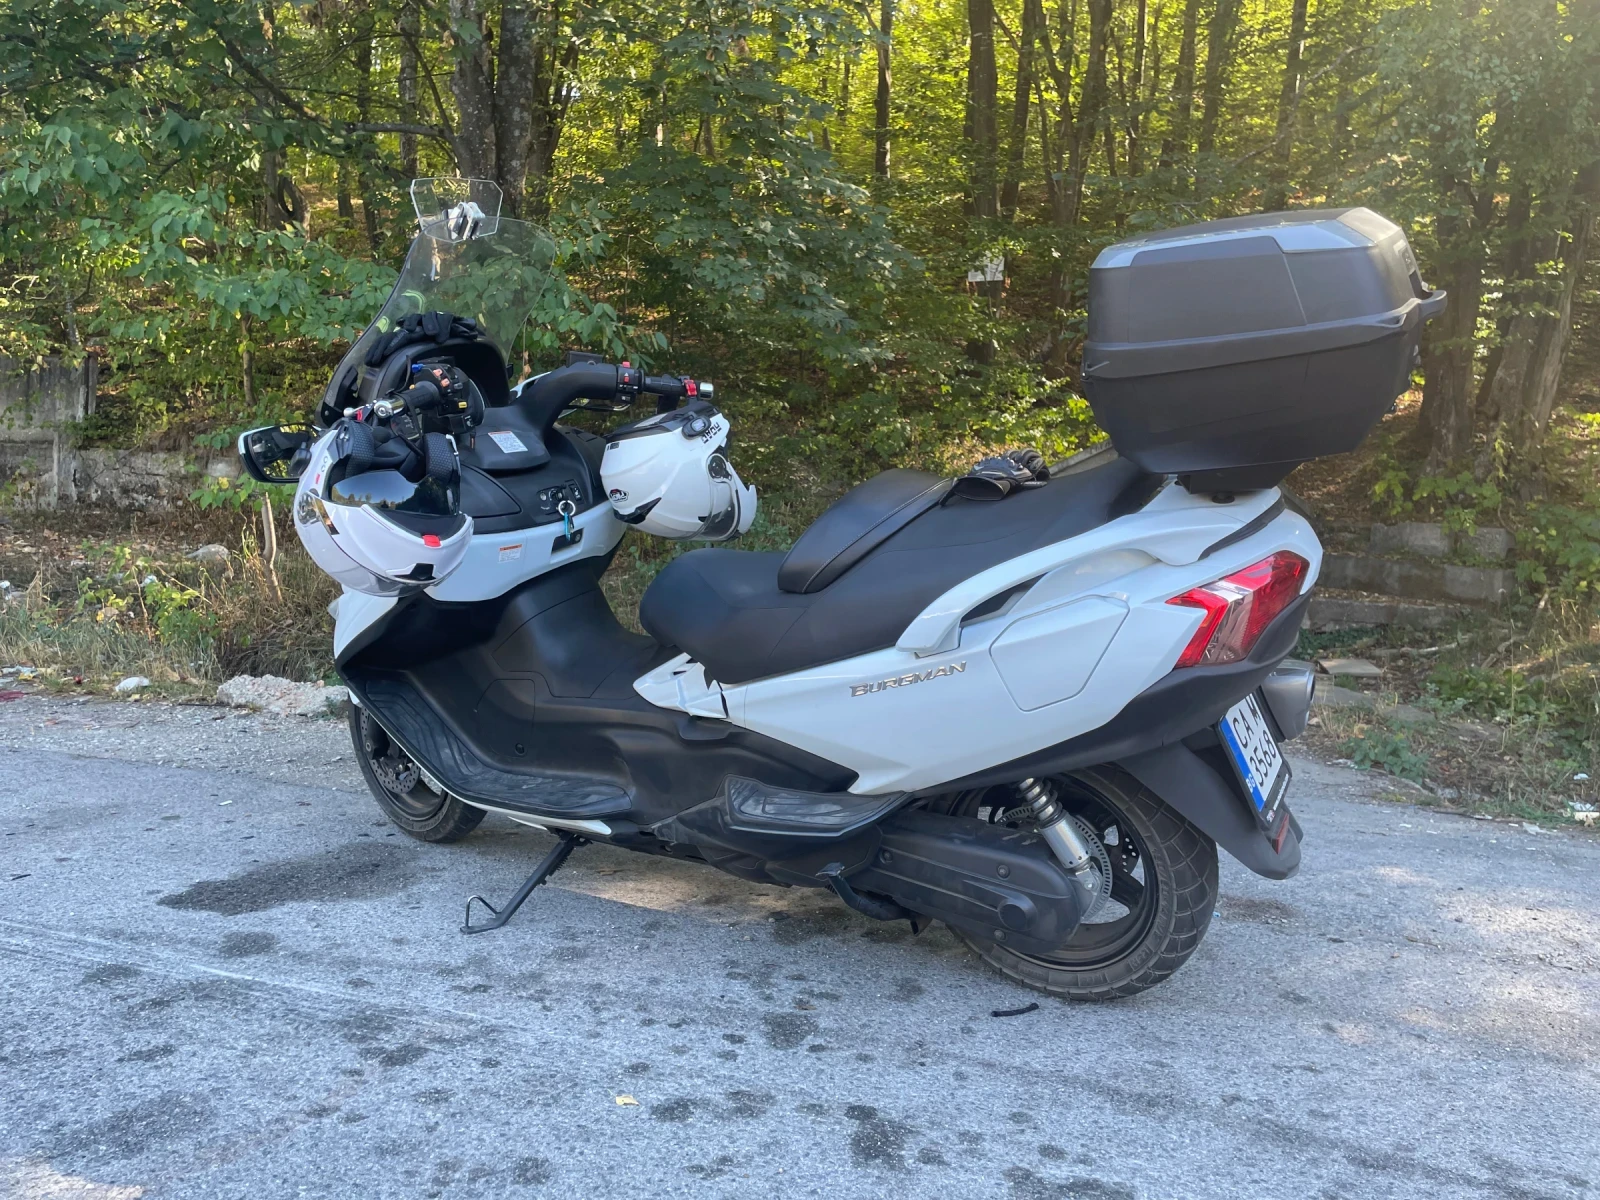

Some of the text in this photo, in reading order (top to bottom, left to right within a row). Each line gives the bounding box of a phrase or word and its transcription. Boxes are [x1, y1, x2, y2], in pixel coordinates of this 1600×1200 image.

[849, 660, 967, 698] BURGMAN
[1232, 708, 1255, 749] CA
[1249, 729, 1277, 788] 3568
